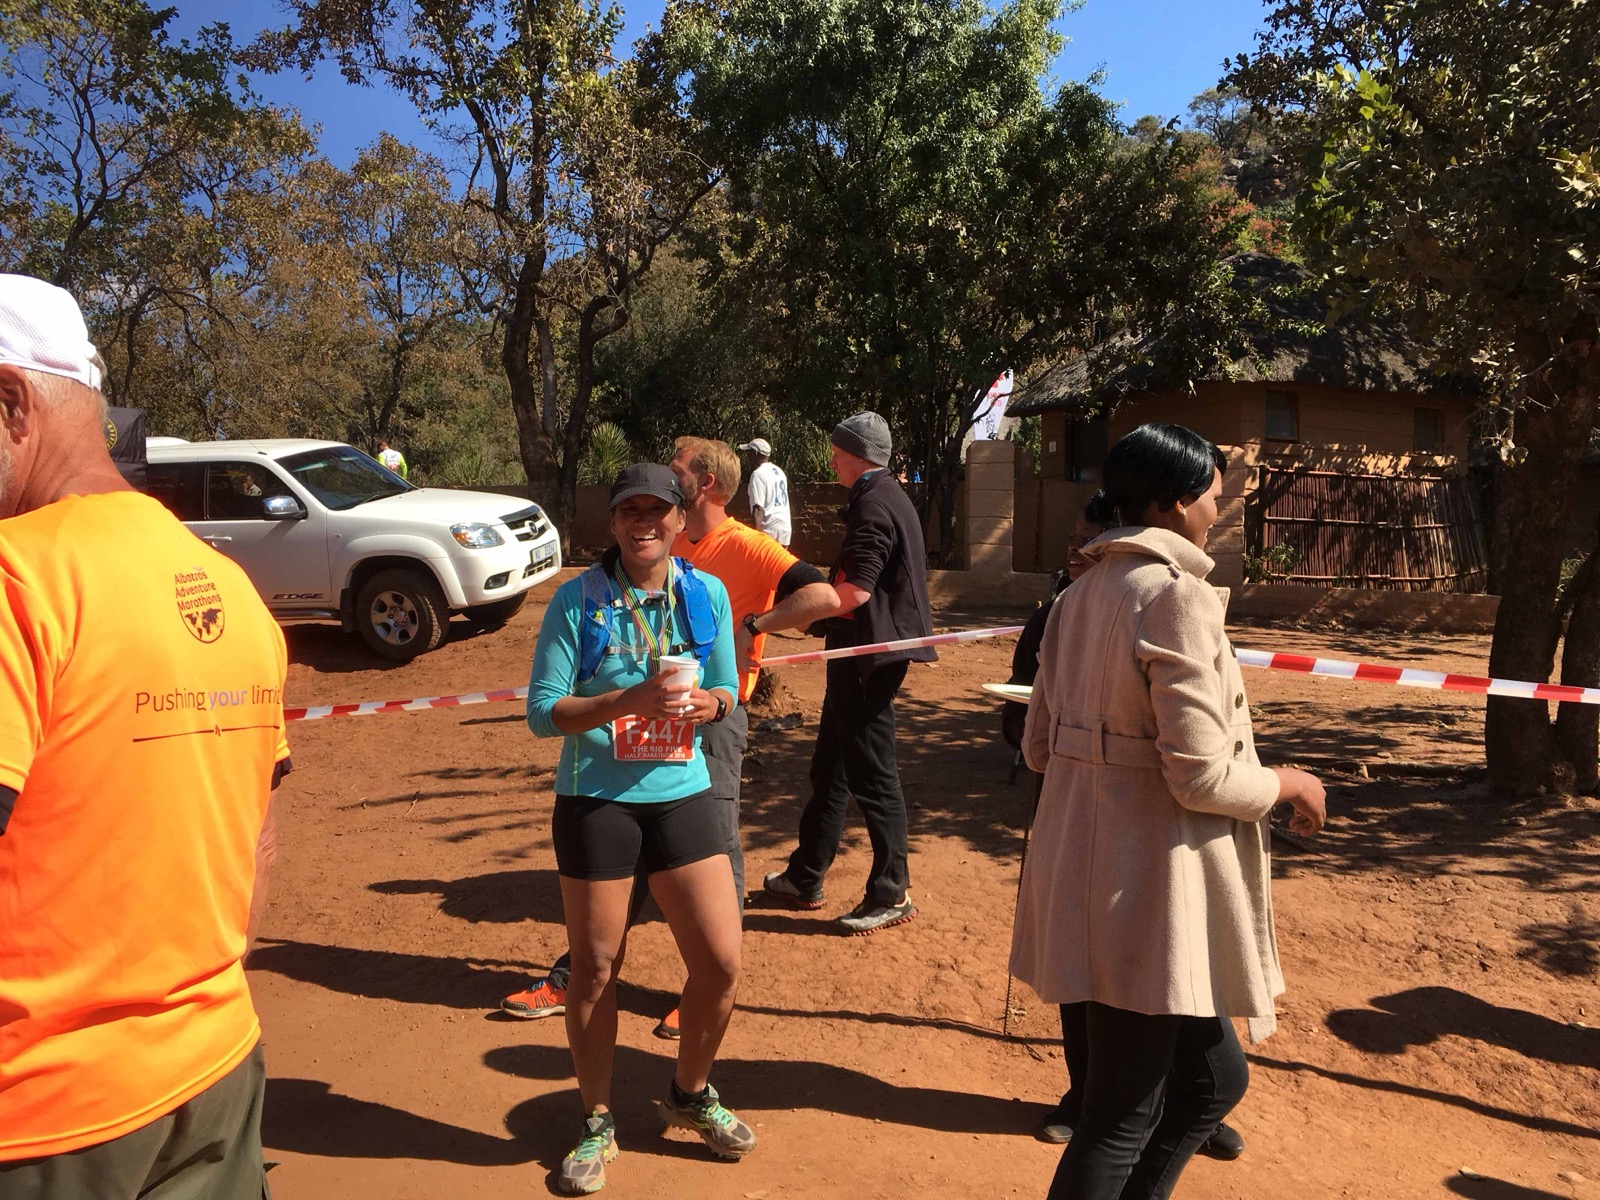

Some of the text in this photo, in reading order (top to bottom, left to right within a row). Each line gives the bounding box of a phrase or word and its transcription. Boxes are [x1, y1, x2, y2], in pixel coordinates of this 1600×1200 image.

[174, 571, 208, 585] Albatros
[175, 582, 217, 598] Adventure
[177, 594, 222, 611] Marathons
[135, 687, 207, 714] Pushing
[208, 690, 248, 711] your
[632, 745, 683, 753] THE BIG FIVE
